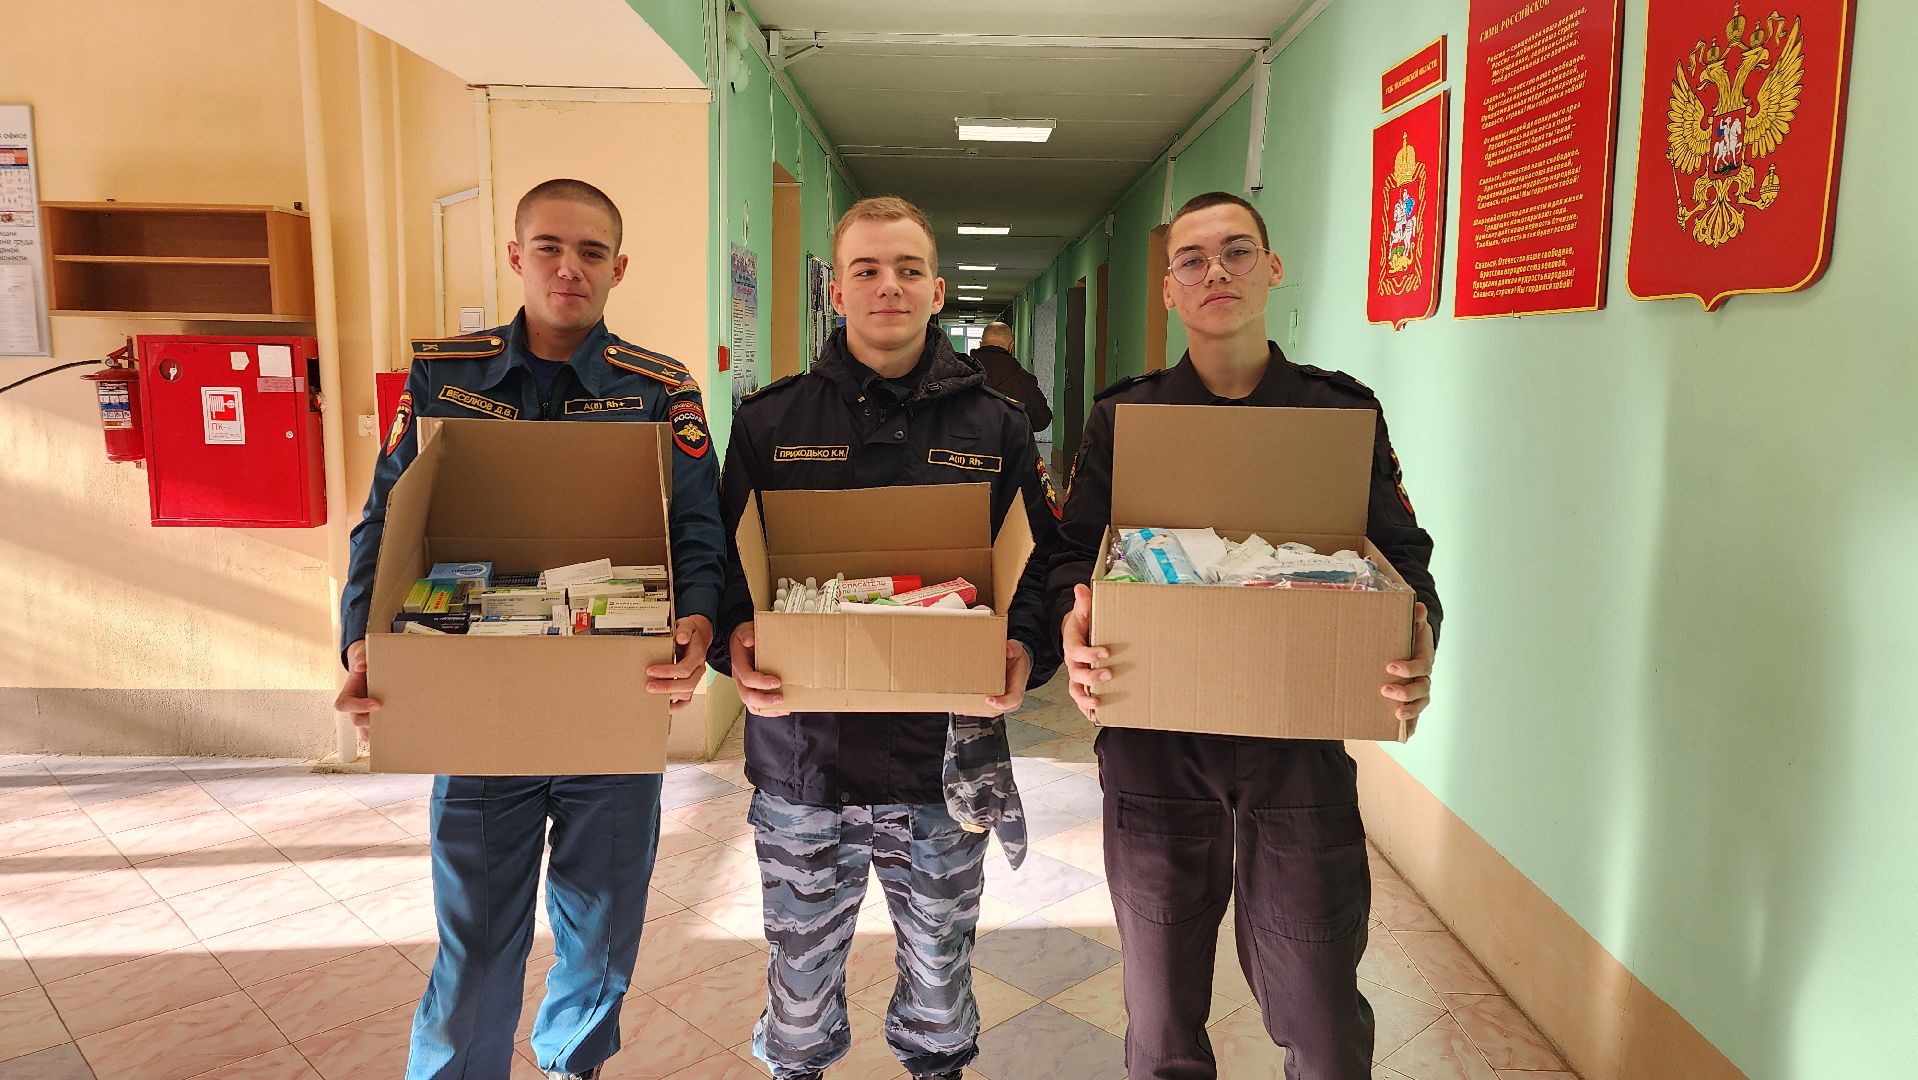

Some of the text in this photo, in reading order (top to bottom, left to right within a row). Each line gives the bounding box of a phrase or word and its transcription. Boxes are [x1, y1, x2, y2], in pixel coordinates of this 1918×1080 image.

[446, 389, 514, 419] ВЕСЕЛКОВ Д.В.
[606, 401, 626, 410] Rh+
[780, 449, 846, 458] ПРИХОДЬКО К.Н.
[968, 457, 984, 466] Rh-
